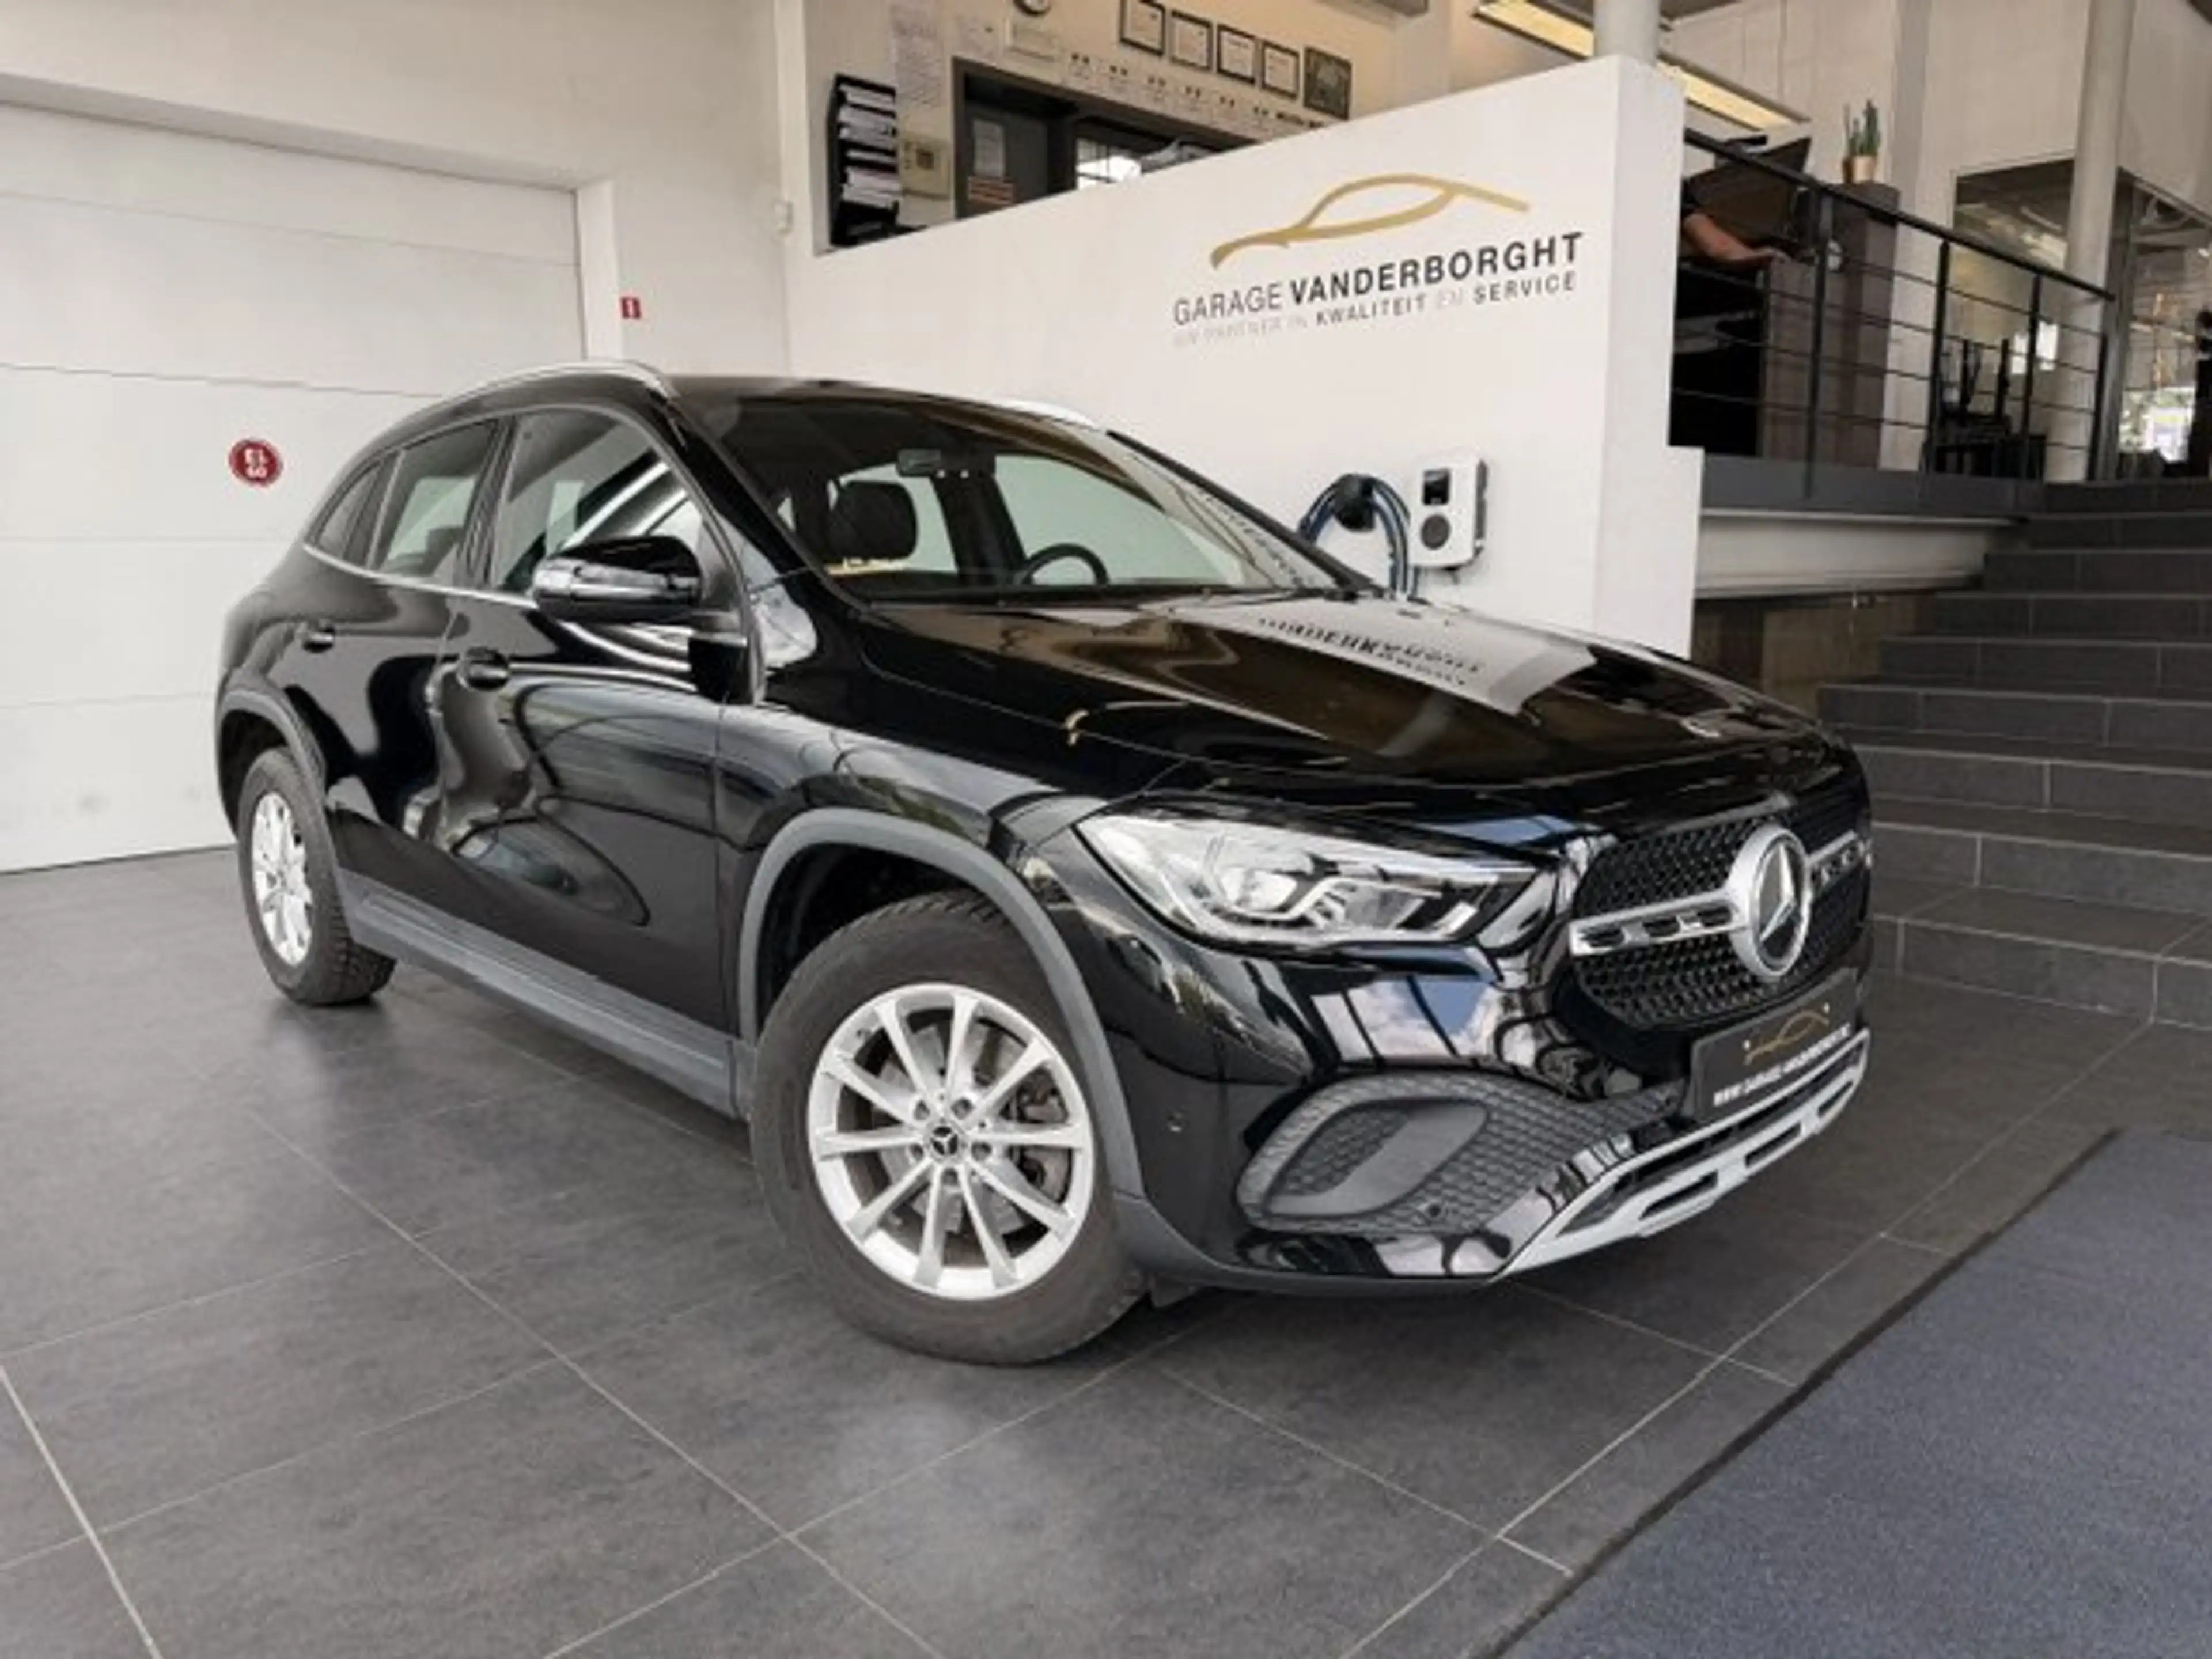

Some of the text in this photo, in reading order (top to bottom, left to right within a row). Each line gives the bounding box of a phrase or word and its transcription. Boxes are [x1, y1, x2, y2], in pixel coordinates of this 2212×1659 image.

[1173, 230, 1585, 326] GARAGE VANDERBORGHT
[1316, 293, 1426, 326] KWALITEIT
[1473, 271, 1576, 305] SERVICE
